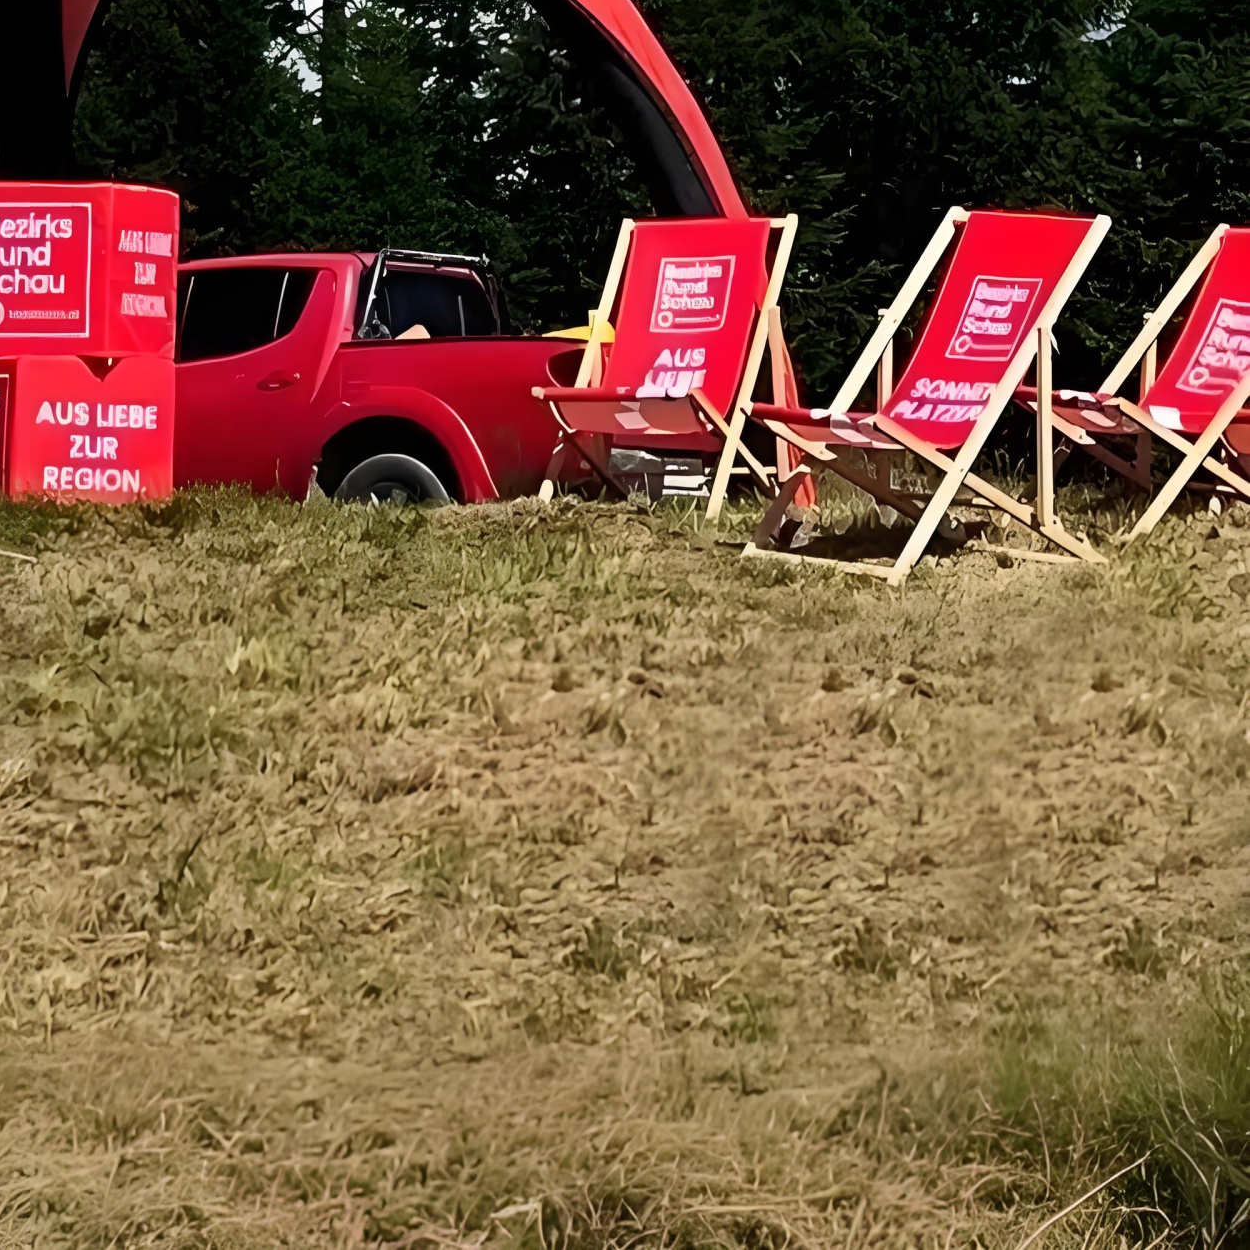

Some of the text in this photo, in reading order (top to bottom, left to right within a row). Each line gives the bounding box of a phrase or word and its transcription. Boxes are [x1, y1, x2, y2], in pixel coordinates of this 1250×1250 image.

[653, 347, 706, 367] AUS
[36, 401, 158, 430] AUS LIEBE
[70, 434, 118, 460] ZUR
